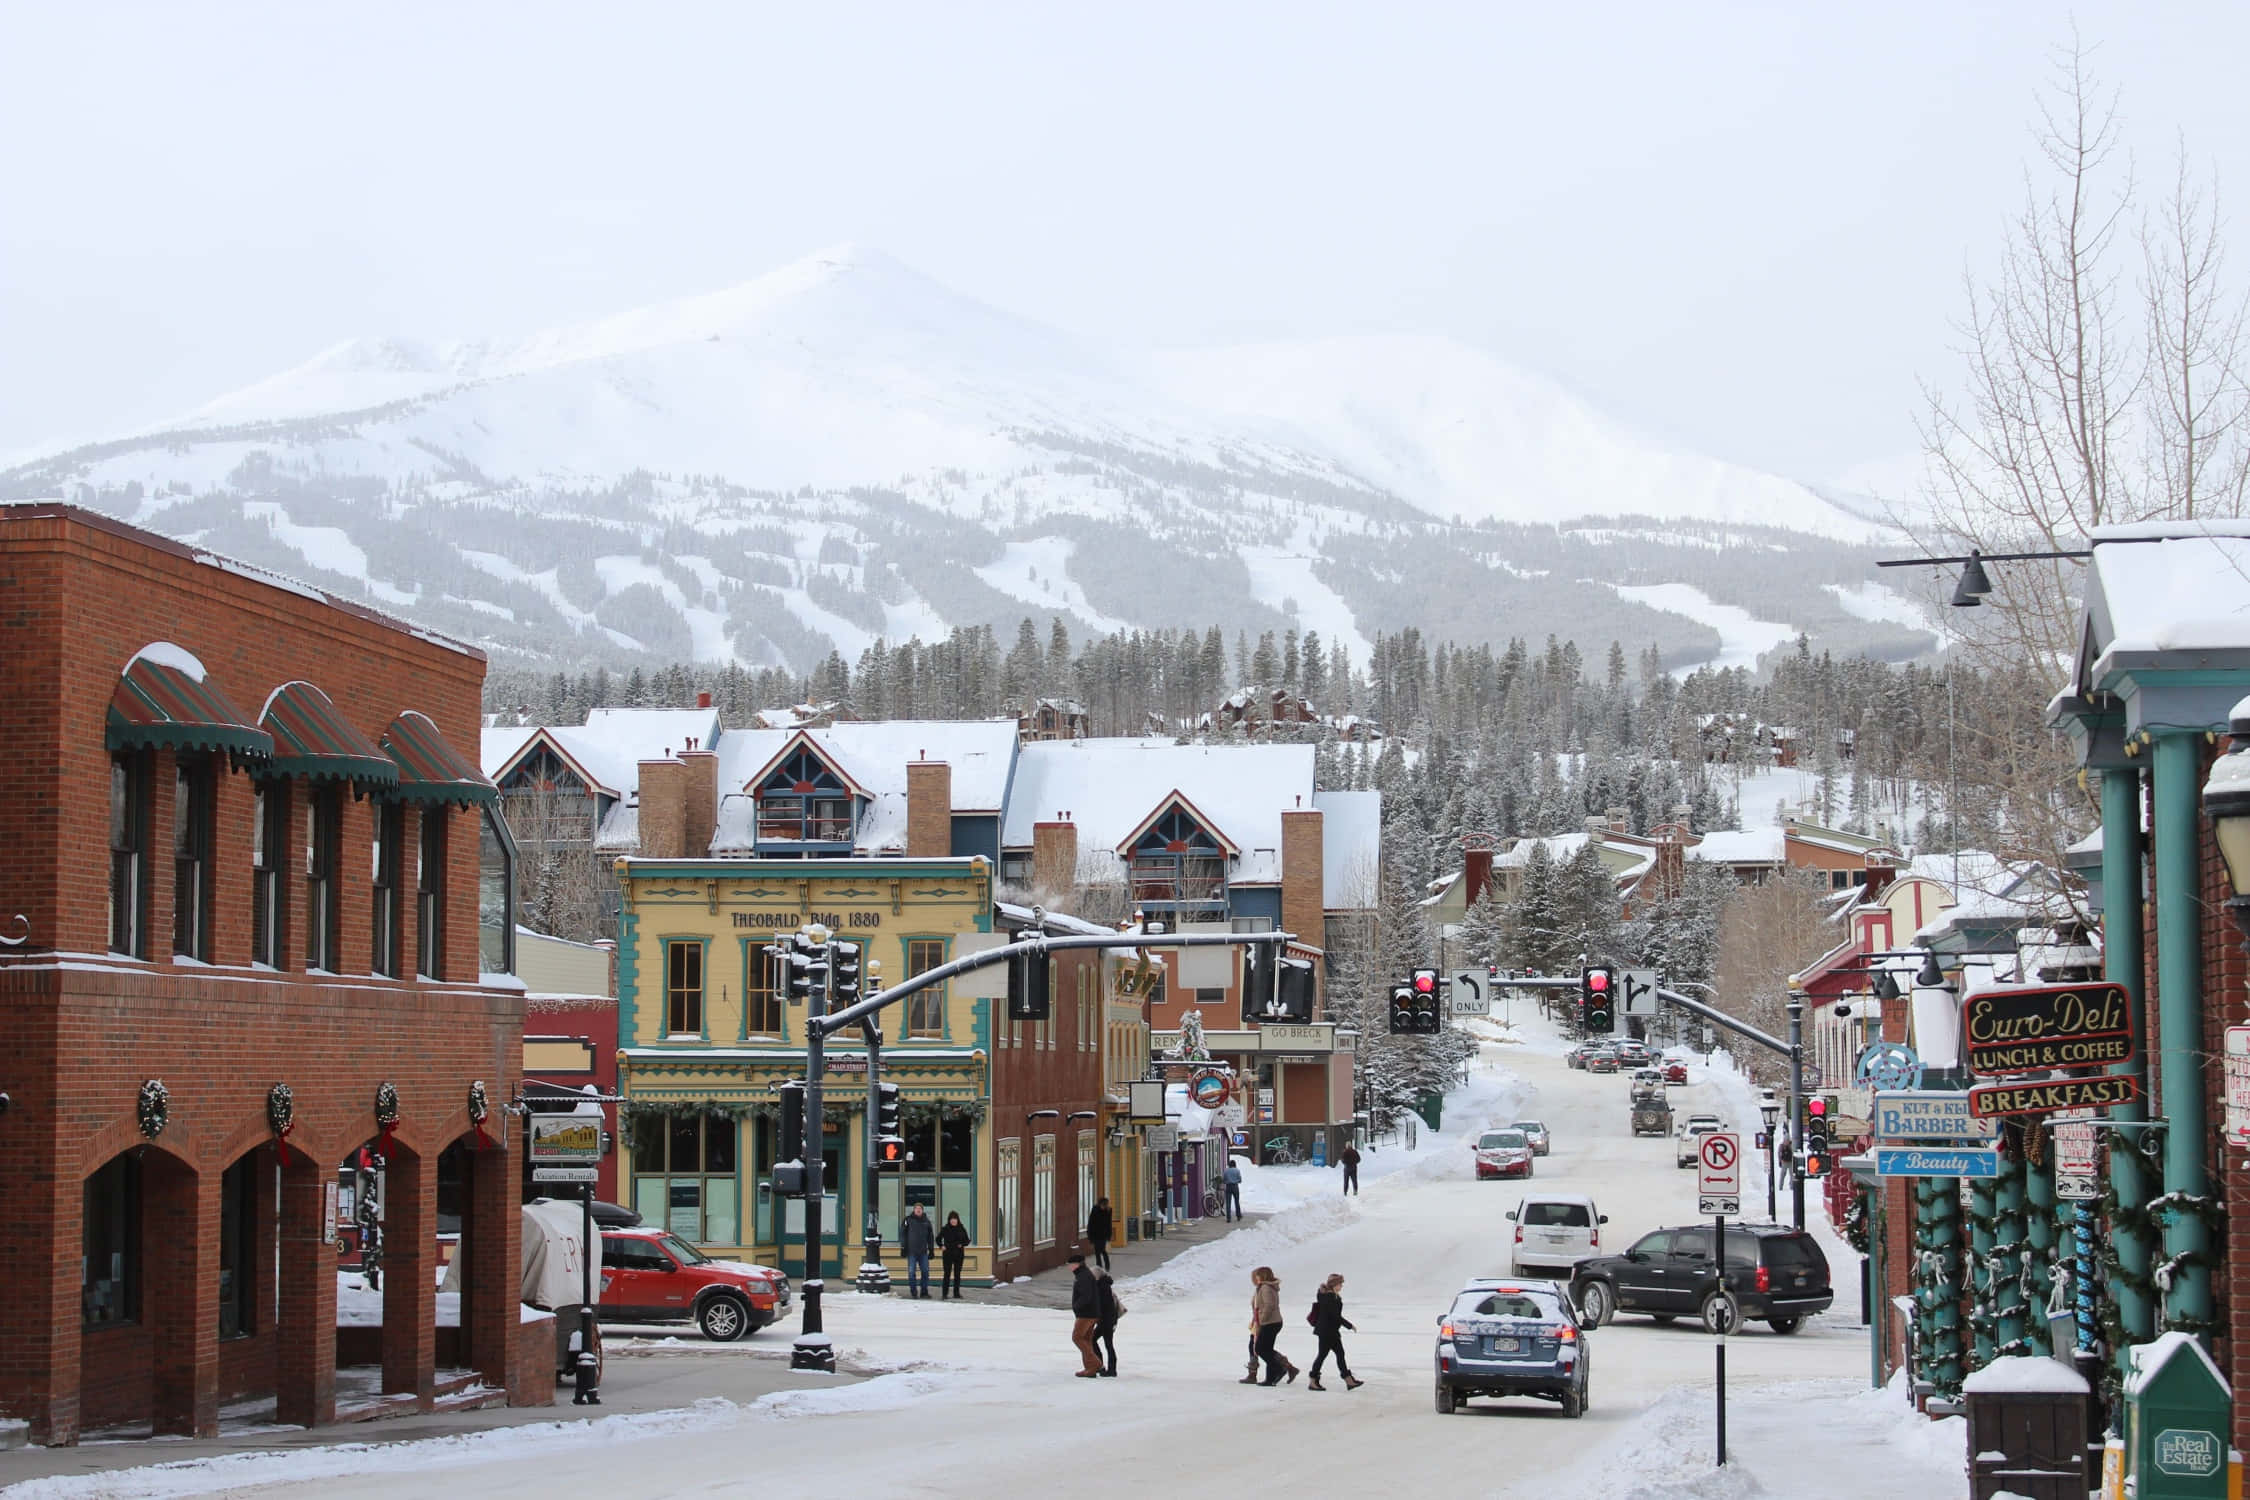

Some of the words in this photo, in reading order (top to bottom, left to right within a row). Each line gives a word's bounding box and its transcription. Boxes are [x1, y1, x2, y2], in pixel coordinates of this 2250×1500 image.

[731, 912, 800, 928] THEOBALD
[810, 911, 844, 931] Bldg.
[849, 912, 880, 927] 1880
[1456, 1002, 1484, 1011] ONLY
[1970, 989, 2124, 1041] Euro-Deli
[1271, 1028, 1287, 1038] GO
[1290, 1027, 1322, 1038] BRECK
[1973, 1047, 2037, 1070] LUNCH
[2042, 1047, 2056, 1063] &
[2061, 1041, 2125, 1061] COFFEE
[1980, 1080, 2128, 1114] BREAKFAST
[1903, 1103, 1930, 1114] KUT
[1883, 1110, 1969, 1134] BARBER
[1904, 1153, 1971, 1175] Beauty
[568, 1171, 595, 1180] Rentals
[2175, 1435, 2210, 1453] Real
[2162, 1448, 2212, 1466] Estate
